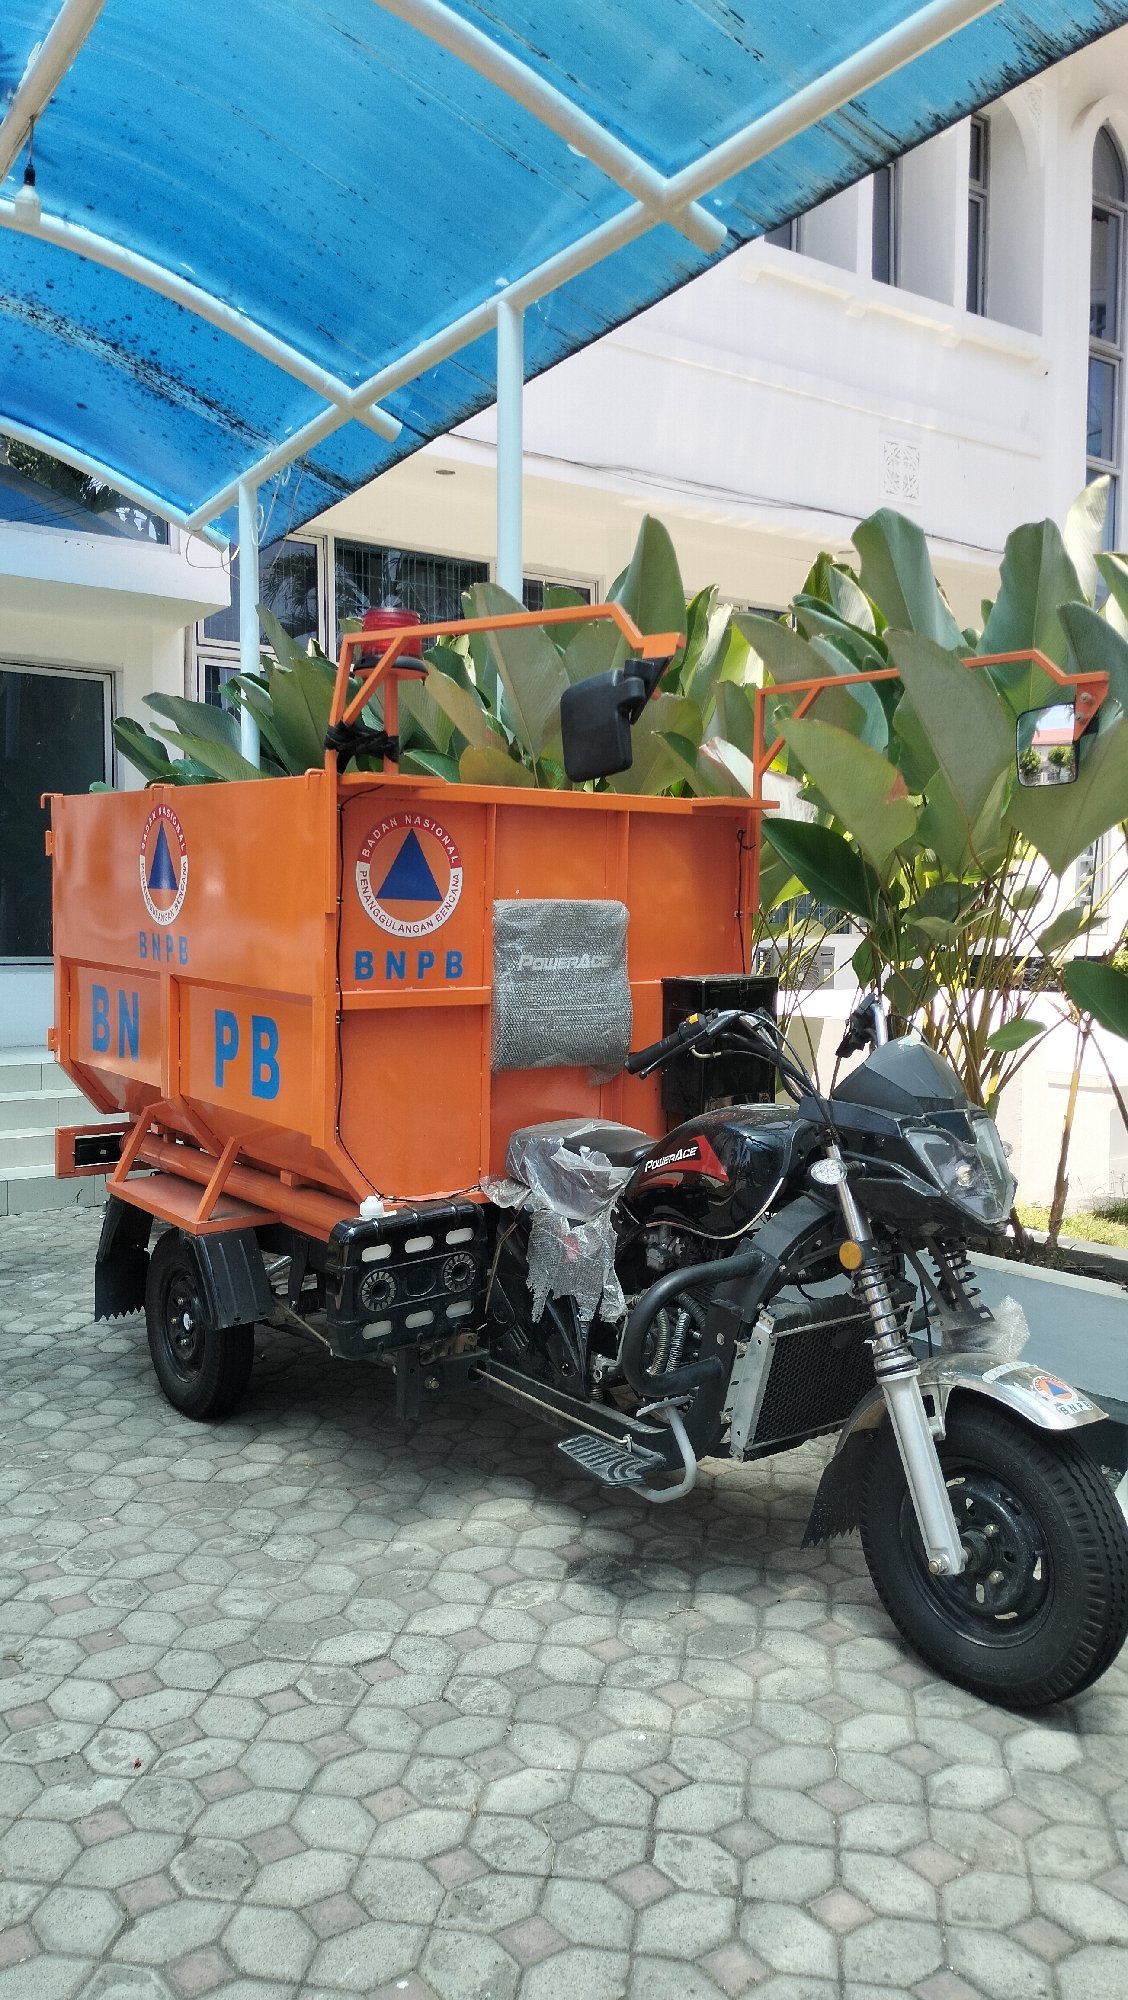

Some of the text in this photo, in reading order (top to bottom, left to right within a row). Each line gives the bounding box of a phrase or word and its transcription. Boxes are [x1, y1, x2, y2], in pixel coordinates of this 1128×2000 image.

[361, 815, 459, 863] BADAN NASIONAL
[359, 870, 460, 934] PENANGGULANGAN BENCANA
[139, 931, 189, 965] BNPB
[355, 950, 464, 980] BNPB
